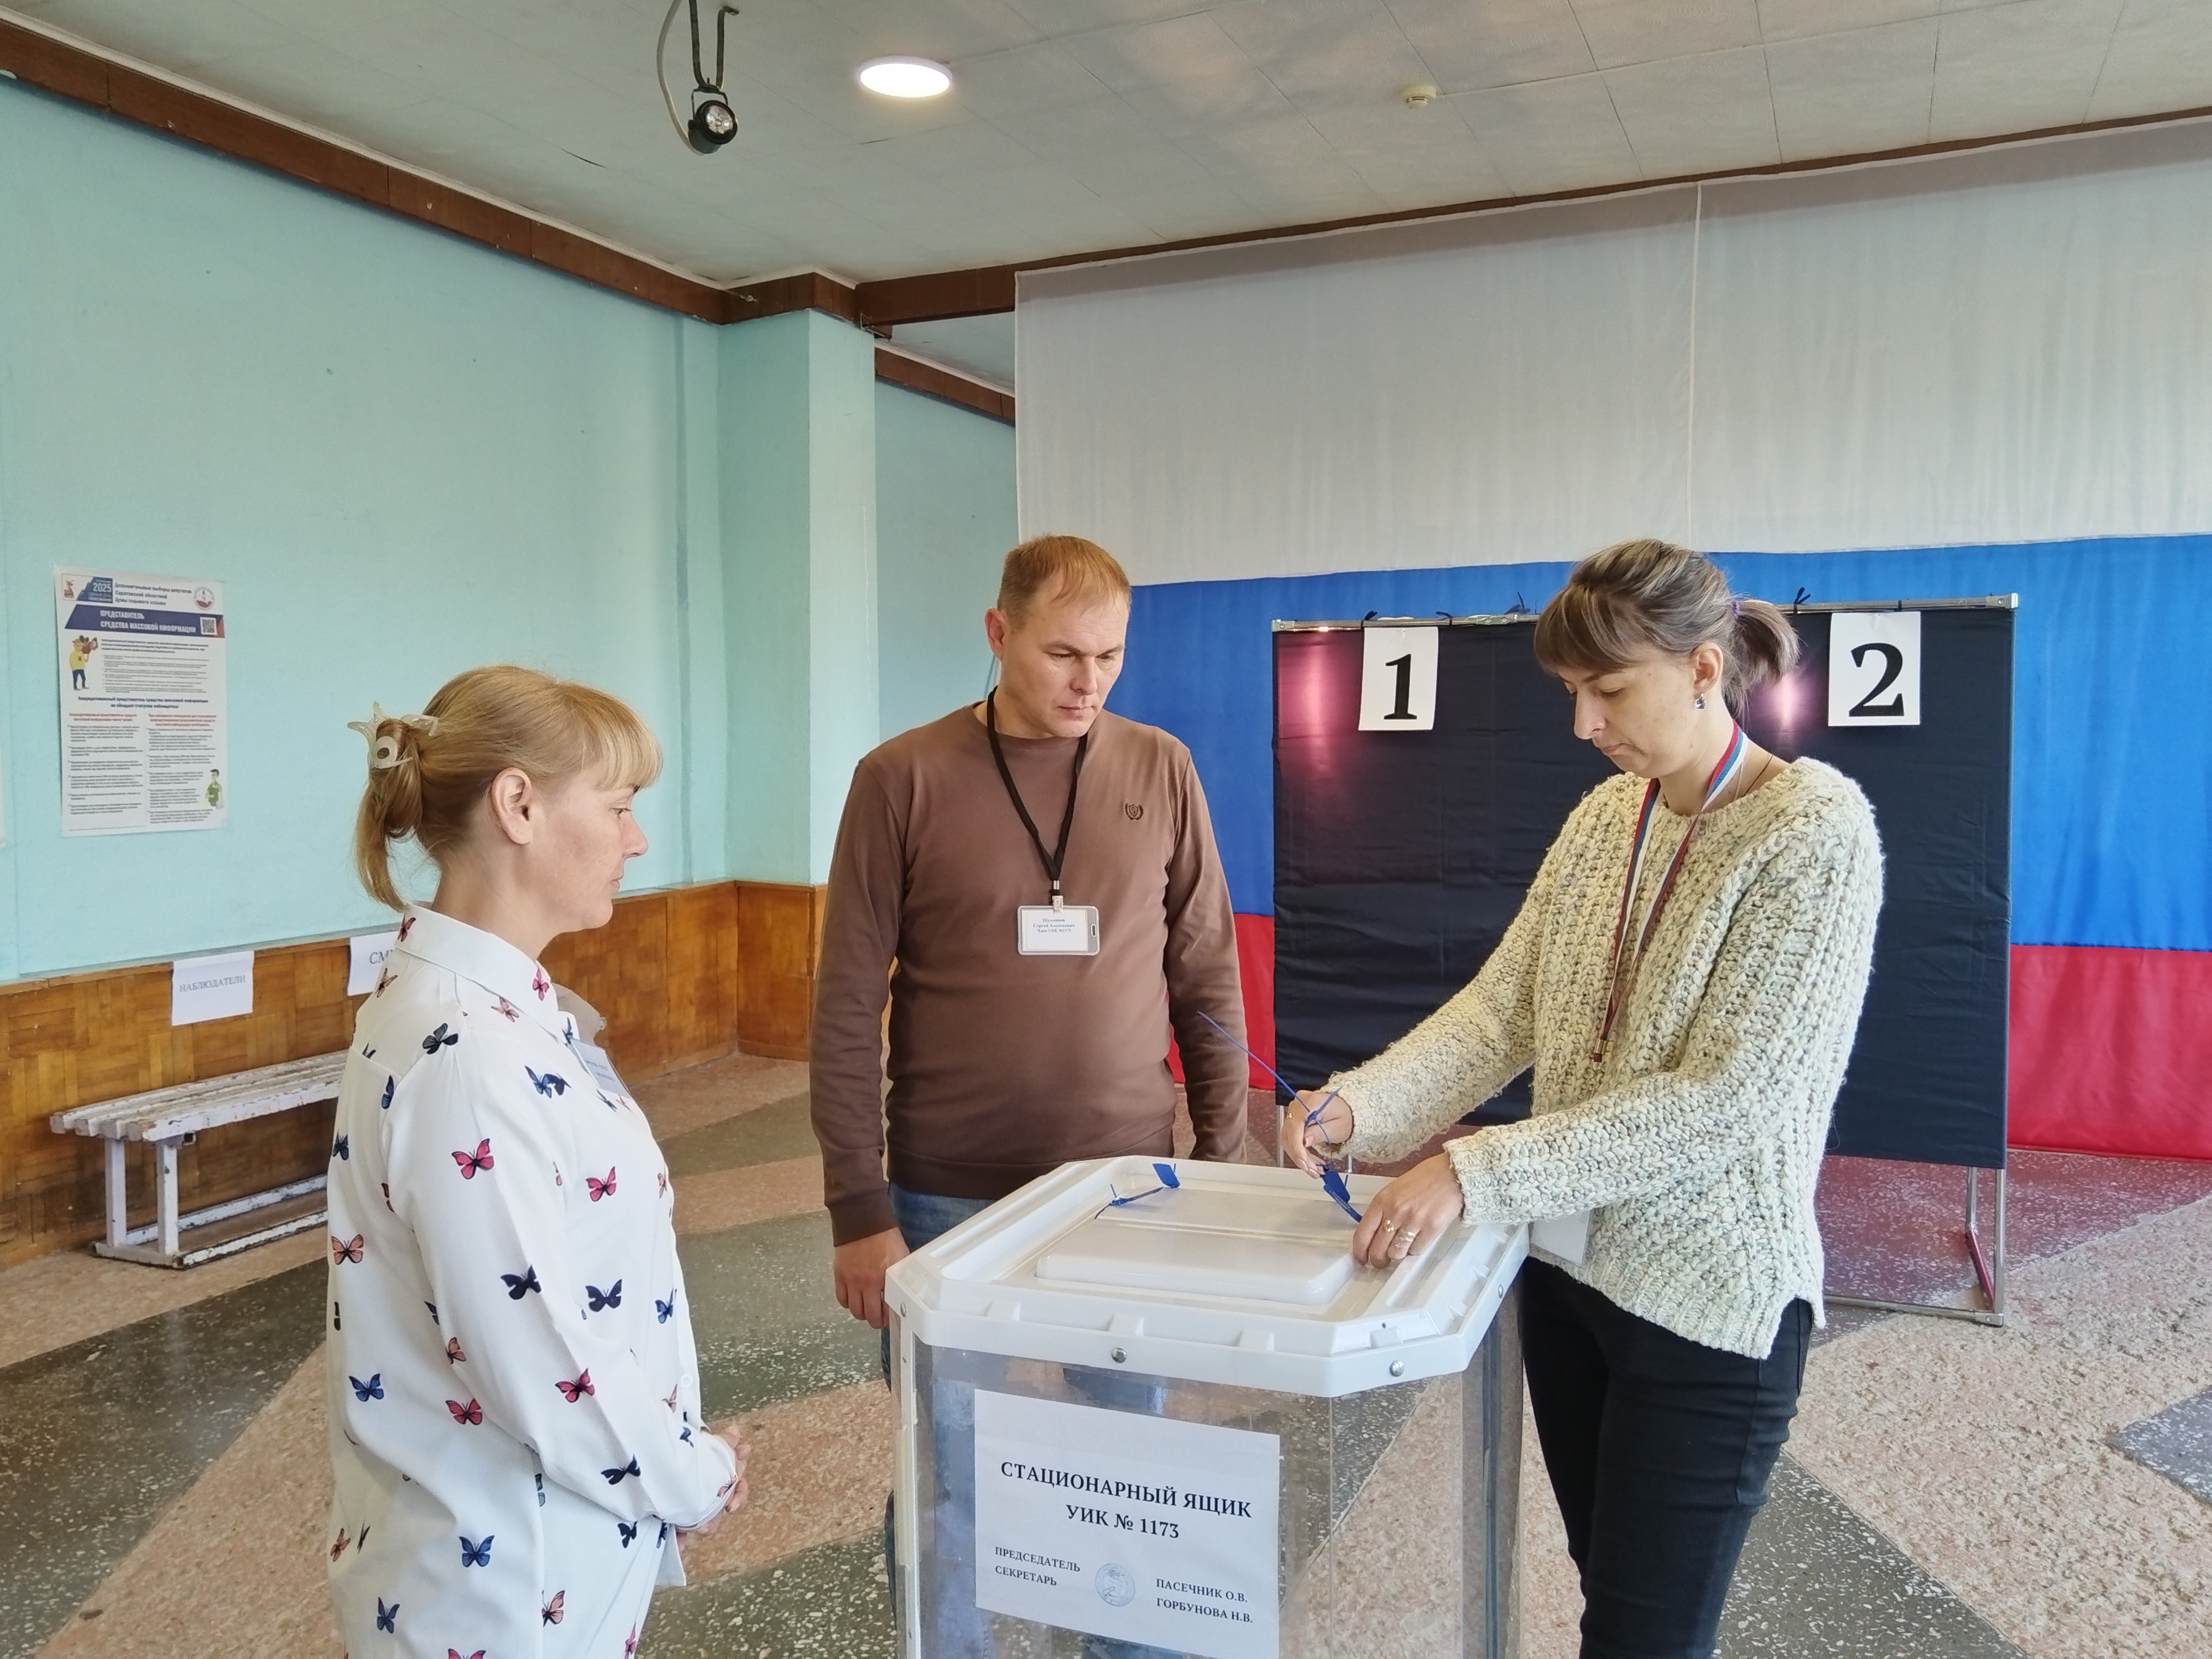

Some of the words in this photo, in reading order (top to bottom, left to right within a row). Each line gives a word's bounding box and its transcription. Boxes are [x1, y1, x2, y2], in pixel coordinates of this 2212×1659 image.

[93, 582, 111, 592] 2025
[100, 610, 145, 619] ПРЕДСТАВИТЕЛЬ
[1383, 654, 1417, 720] 1
[1849, 643, 1905, 717] 2
[369, 949, 393, 964] СМ
[180, 974, 246, 993] НАБЛЮДАТЕЛИ
[1001, 1462, 1177, 1506] СТАЦИОНАРНЫЙ
[1183, 1493, 1252, 1518] ЯЩИК
[1066, 1504, 1109, 1526] УИК
[1113, 1514, 1134, 1531] №
[1140, 1519, 1179, 1538] 1173
[995, 1546, 1080, 1572] ПРЕДСЕДАТЕЛЬ
[995, 1566, 1057, 1586] СЕКРЕТАРЬ
[1156, 1578, 1222, 1599] ПАСЕЧНИК
[1225, 1591, 1248, 1603] О.В.
[1156, 1598, 1228, 1619] ГОРБУНОВА
[1231, 1611, 1253, 1623] Н.В.
